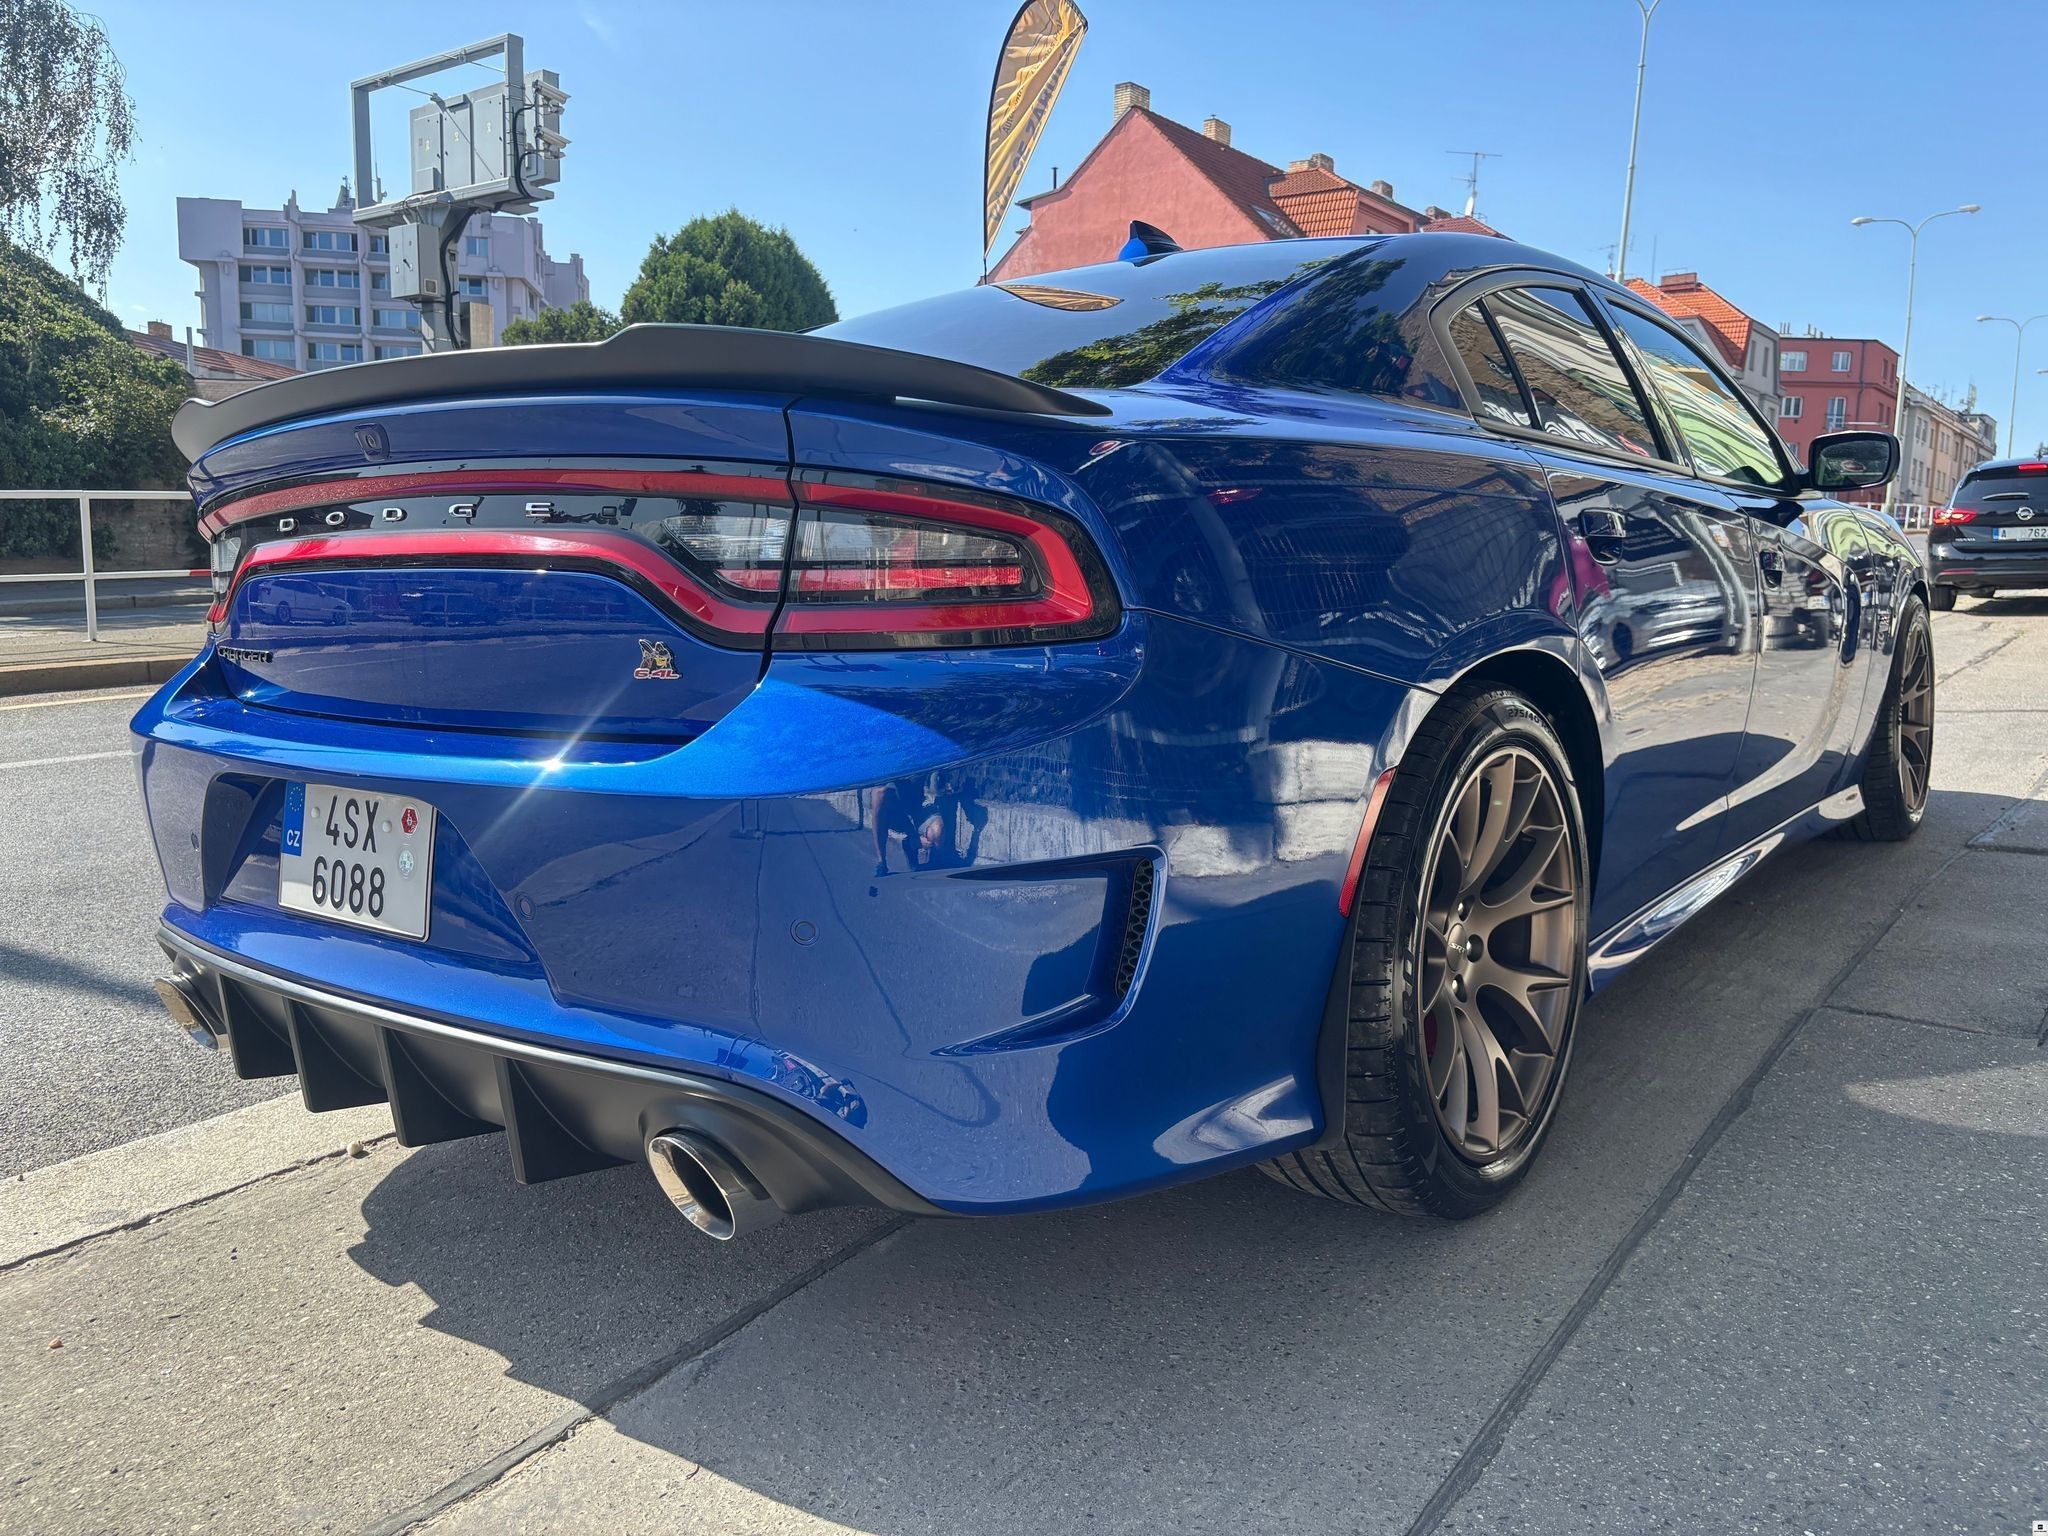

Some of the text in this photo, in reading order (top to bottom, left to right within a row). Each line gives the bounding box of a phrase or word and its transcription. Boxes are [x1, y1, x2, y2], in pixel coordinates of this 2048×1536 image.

[279, 502, 551, 533] DODGE
[2028, 528, 2048, 538] 762
[633, 668, 681, 680] 6.4L
[1508, 708, 1540, 724] 275/40
[325, 795, 379, 853] 4SX
[286, 829, 301, 847] CZ
[312, 855, 385, 918] 6088
[1448, 942, 1467, 954] SRT
